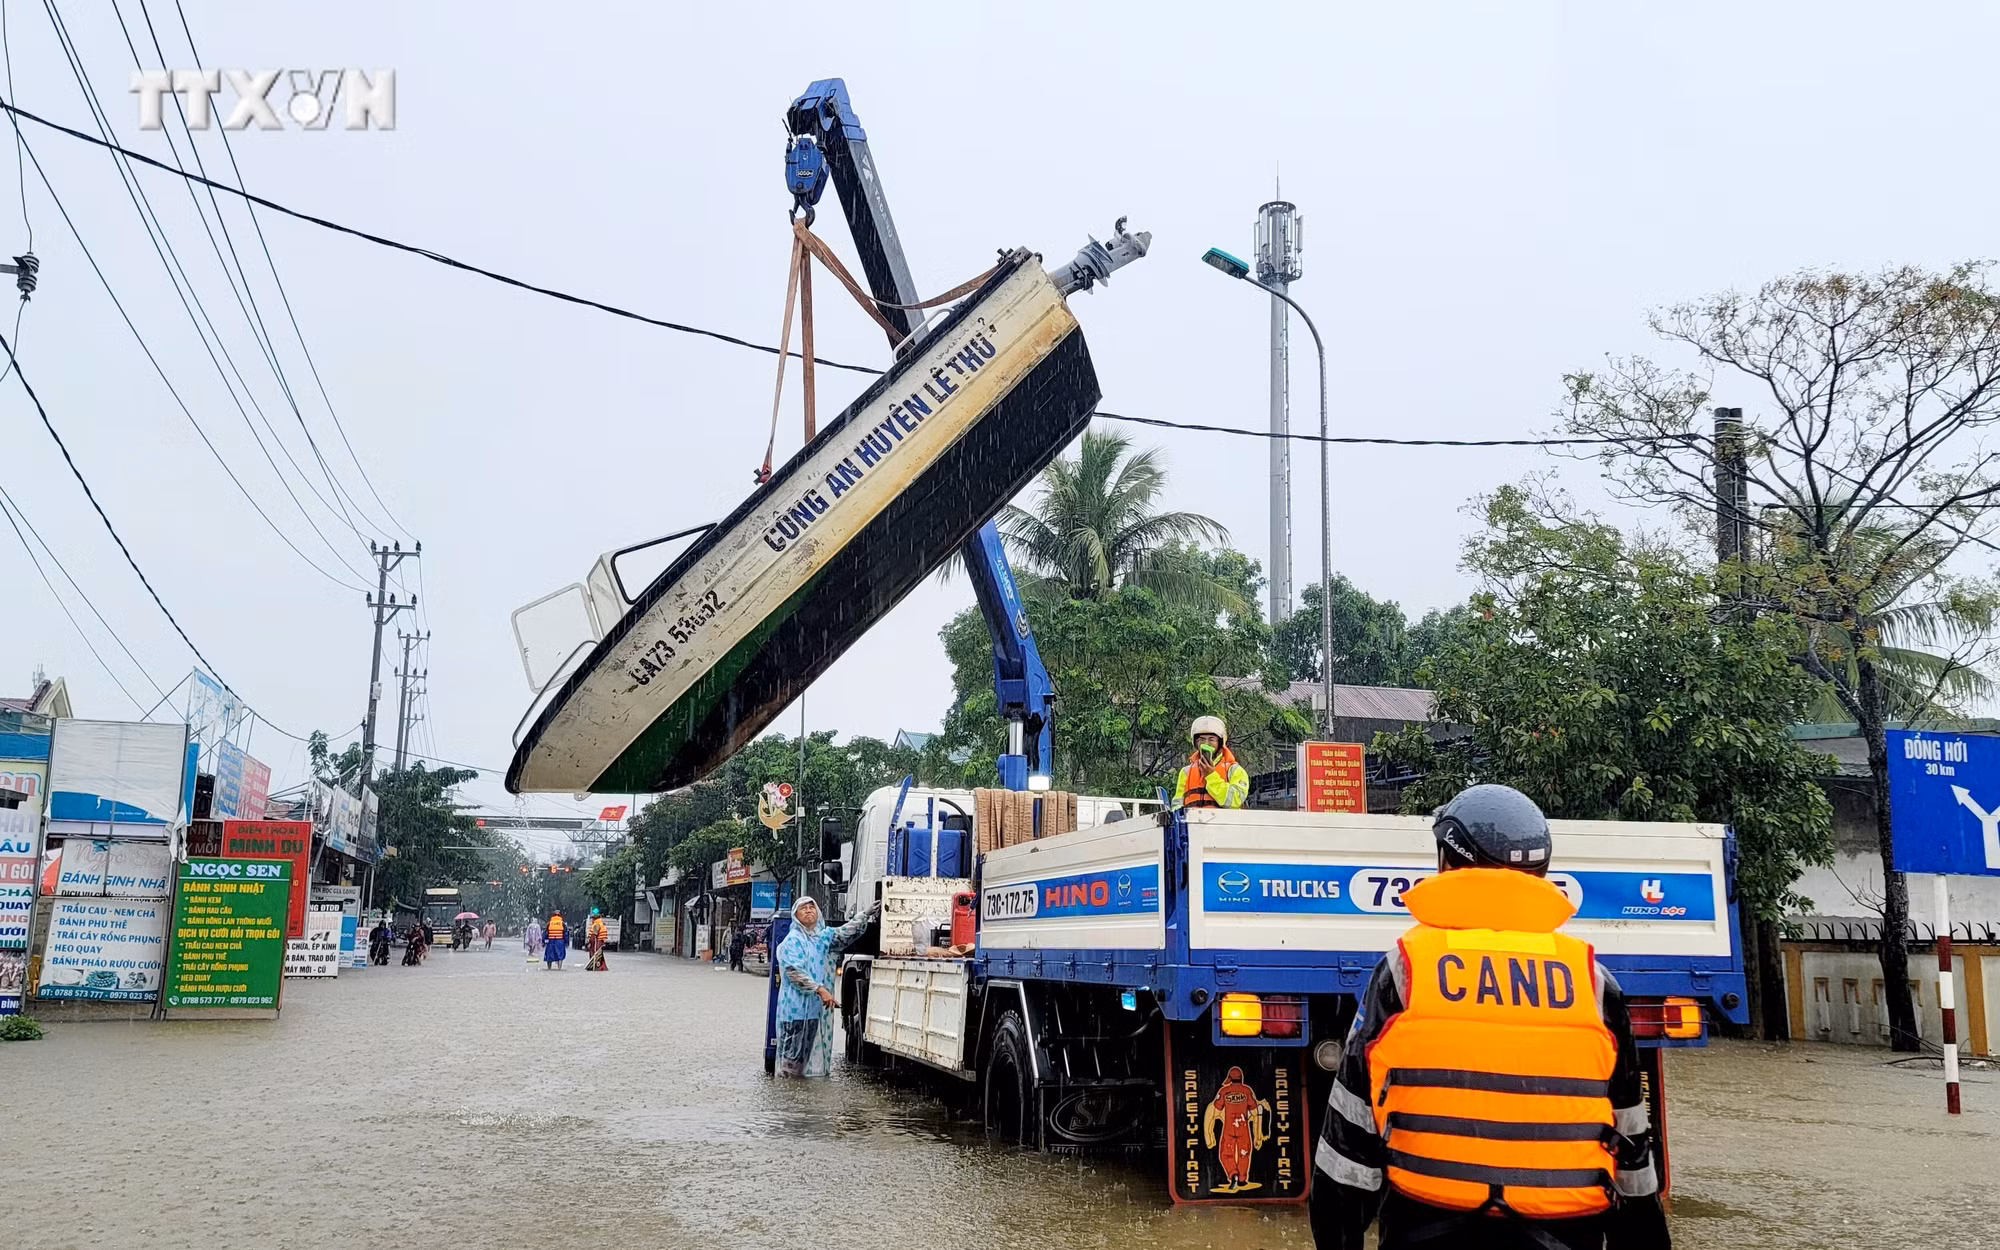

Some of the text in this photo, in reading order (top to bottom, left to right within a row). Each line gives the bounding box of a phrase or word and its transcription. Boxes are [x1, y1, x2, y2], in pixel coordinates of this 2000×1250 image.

[825, 458, 864, 499] AN
[627, 639, 676, 686] CA73
[1904, 732, 1968, 763] ĐỒNG HỚI
[1925, 763, 1955, 777] 30 km
[229, 838, 275, 853] MINH
[1442, 827, 1475, 863] Vespa
[189, 863, 282, 879] NGỌC SEN
[61, 870, 101, 885] BÁNH
[139, 875, 169, 892] NHẬ
[183, 881, 265, 896] BÁNH SINH NHẬT
[312, 887, 322, 895] TIN
[322, 887, 333, 896] HỌC
[1258, 879, 1340, 899] TRUCKS
[190, 895, 206, 904] BÁNH
[987, 889, 1035, 917] 73C-172.75
[1045, 880, 1110, 909] HINO
[88, 906, 107, 916] CAU
[114, 907, 135, 917] NEM
[137, 908, 156, 919] CHẢ
[188, 906, 205, 914] BÁNH
[206, 907, 219, 915] RAU
[59, 916, 85, 927] BÁNH
[88, 918, 108, 929] PHU
[187, 916, 205, 925] BÁNH
[223, 918, 235, 926] LAN
[57, 929, 78, 940] TRÁI
[80, 931, 99, 941] CÂY
[128, 935, 161, 946] PHỤNG
[178, 926, 281, 941] DỊCH VỤ CƯỚI HỎI TRỌN GÓI
[54, 943, 103, 955] HEO QUAY
[202, 942, 214, 950] CAU
[215, 942, 229, 950] NEM
[291, 940, 310, 951] CHỮA,
[311, 940, 320, 951] ÉP
[183, 951, 201, 961] BÁNH
[292, 953, 307, 963] BÁN,
[308, 954, 324, 963] TRAO
[52, 956, 79, 967] BÁNH
[81, 957, 107, 968] PHÁO
[109, 958, 136, 971] RƯỢU
[183, 962, 197, 971] TRÁI
[228, 963, 249, 973] PHỤNG
[299, 965, 312, 974] MỚI
[317, 964, 327, 974] CŨ
[180, 974, 212, 982] HEO QUAY
[1437, 954, 1575, 1009] CAND
[179, 983, 197, 993] BÁNH
[55, 989, 73, 998] 0788
[74, 990, 89, 999] 573
[90, 990, 104, 999] 777
[109, 991, 128, 1000] 0979
[129, 992, 143, 1000] 023
[144, 992, 158, 1001] 962
[182, 996, 274, 1005] 0788 573 777 0979 023 962
[1184, 1070, 1200, 1193] SAFETY FIRST
[1275, 1068, 1292, 1190] SAFETY FIRST
